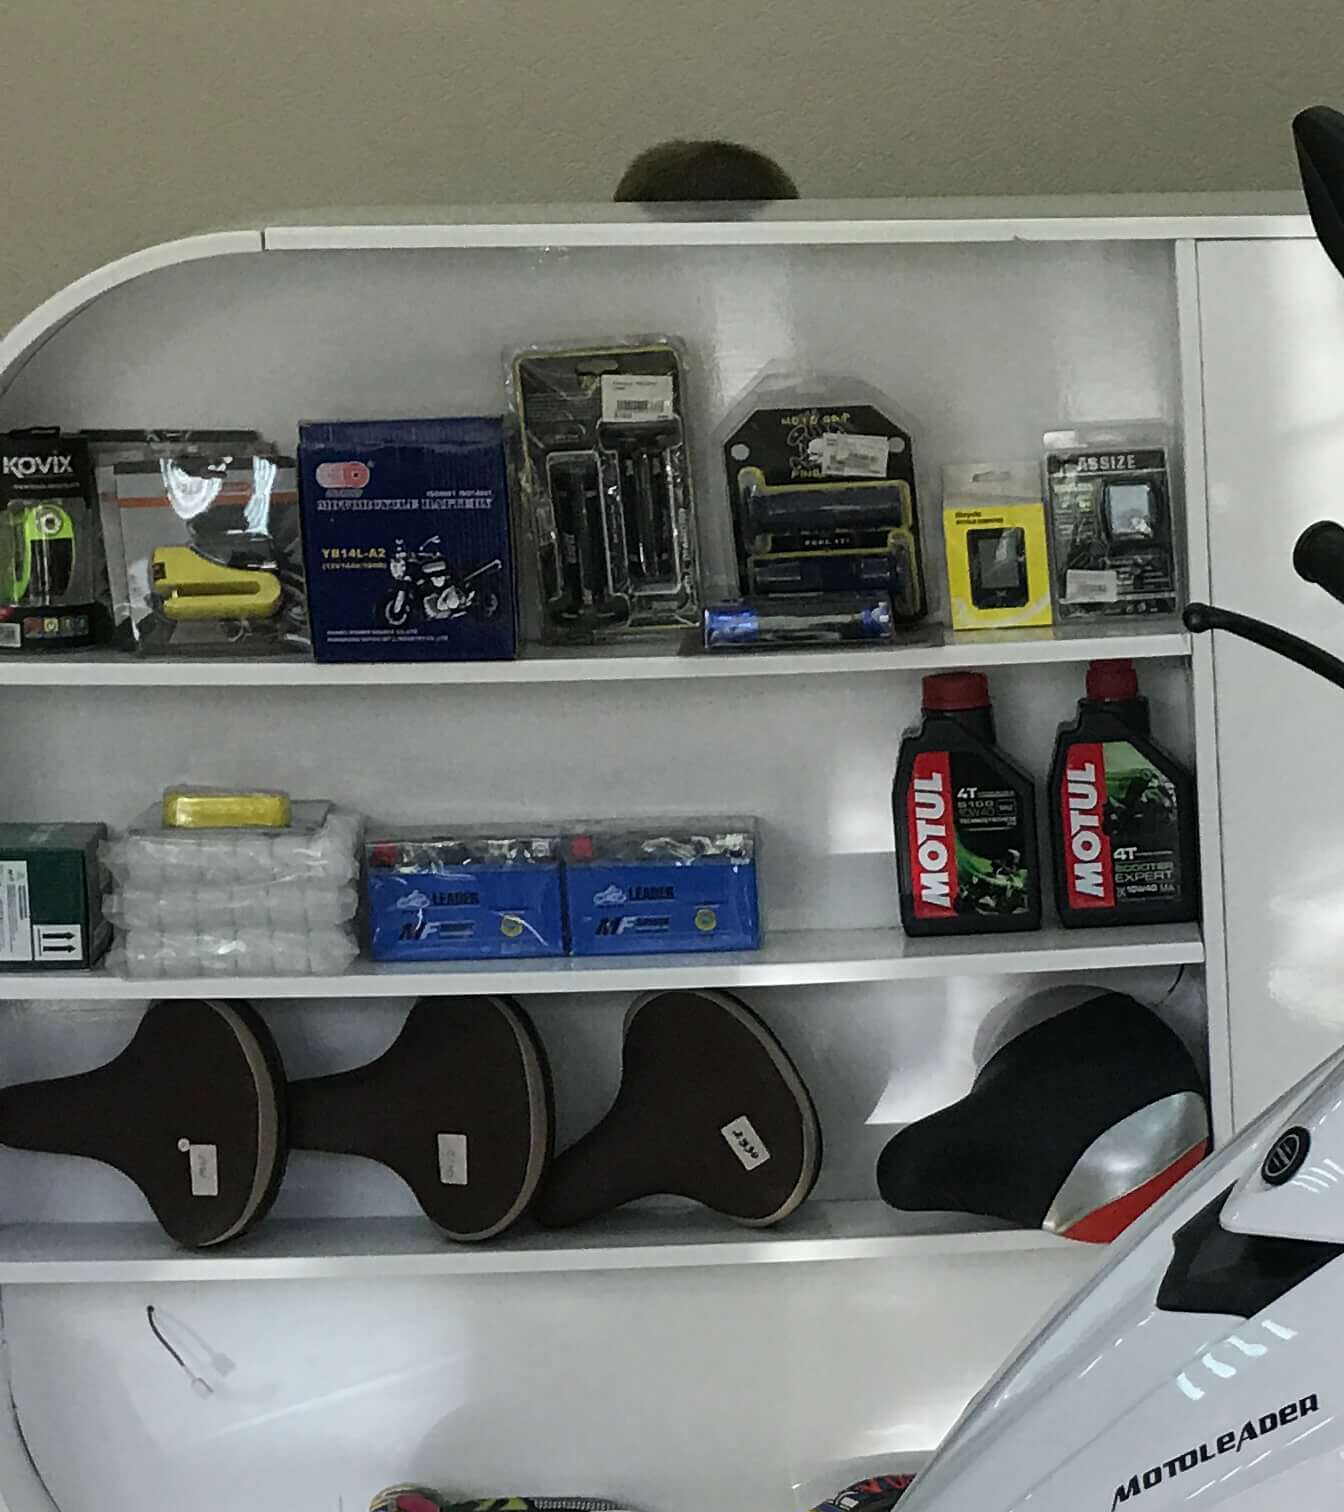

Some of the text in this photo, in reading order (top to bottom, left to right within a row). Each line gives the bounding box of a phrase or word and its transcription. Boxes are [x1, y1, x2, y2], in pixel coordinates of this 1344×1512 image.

[3, 456, 73, 478] KOVIX
[1076, 454, 1136, 472] ASSIZE
[957, 787, 978, 799] 4T
[1066, 763, 1104, 897] MOTUL
[913, 772, 951, 909] MOTUL
[1113, 847, 1138, 860] 4T
[1115, 871, 1172, 883] EXPERT
[431, 892, 480, 905] LEADER
[626, 886, 674, 899] LEADER
[1111, 1393, 1320, 1512] MOTOLEADER
